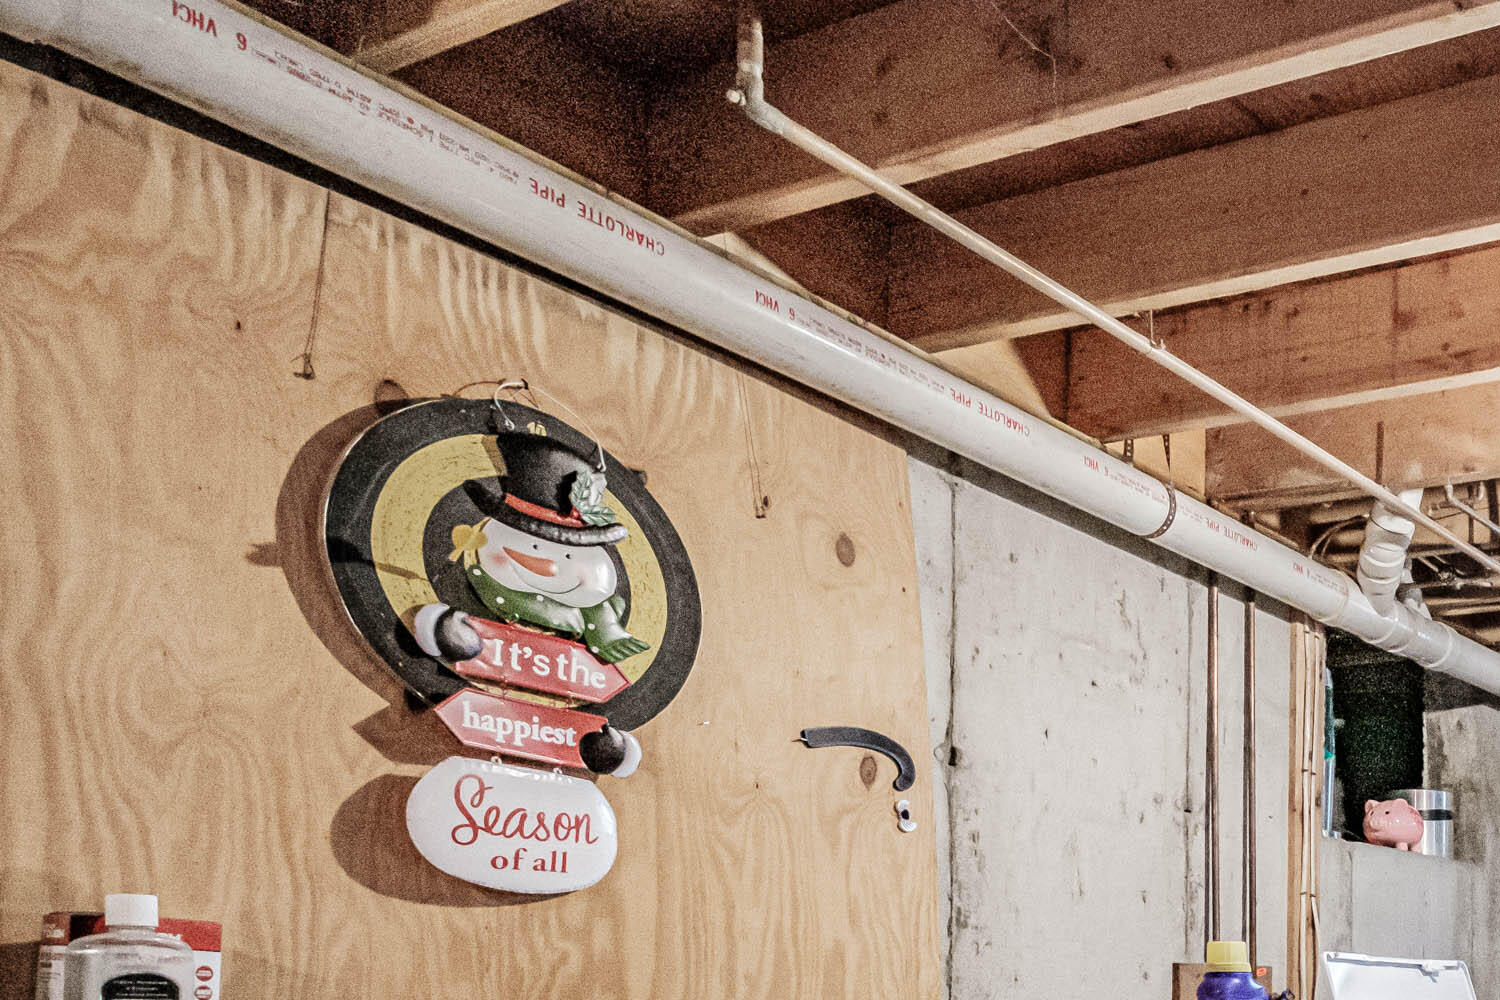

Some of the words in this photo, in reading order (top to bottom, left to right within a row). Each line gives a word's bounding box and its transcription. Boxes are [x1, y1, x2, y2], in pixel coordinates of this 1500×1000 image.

[528, 176, 566, 208] PIPE
[577, 200, 665, 256] CHARLOTTE
[950, 387, 972, 408] PIPE
[977, 401, 1031, 438] CHARLOTTE
[491, 638, 551, 677] It's
[556, 644, 607, 689] the
[461, 700, 577, 747] happiest
[451, 774, 599, 846] Season
[490, 848, 529, 872] of
[532, 851, 569, 874] all
